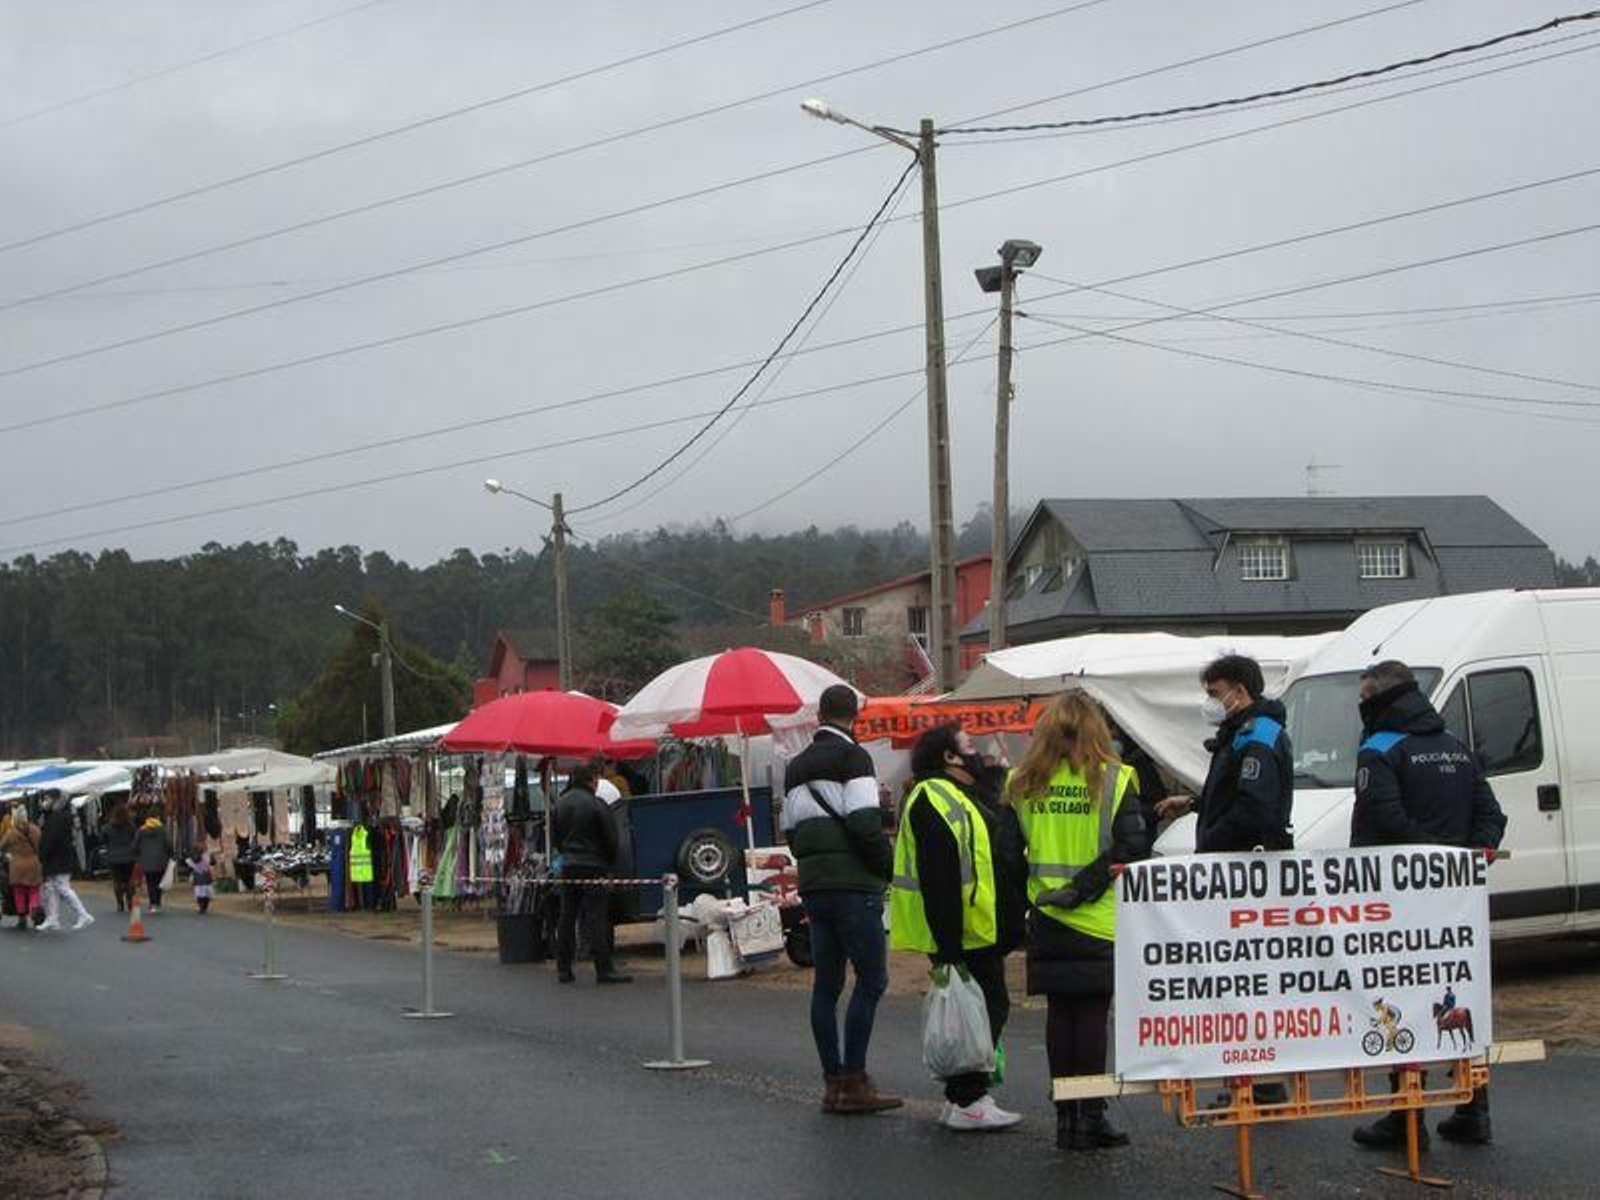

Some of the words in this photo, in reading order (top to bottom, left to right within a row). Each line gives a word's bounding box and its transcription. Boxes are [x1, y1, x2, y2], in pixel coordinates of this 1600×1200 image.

[1122, 860, 1268, 903] MERCADO
[1281, 856, 1317, 897] DE
[1323, 854, 1381, 896] SAN
[1392, 851, 1487, 891] COSME
[1229, 902, 1393, 929] PEÓNS
[1143, 935, 1335, 966] OBRIGATORIO
[1343, 925, 1474, 956] CIRCULAR
[1148, 973, 1269, 1001] SEMPRE
[1280, 968, 1352, 995] POLA
[1363, 960, 1473, 989] DEREITA
[1138, 1012, 1247, 1047] PROHIBIDO
[1254, 1011, 1267, 1041] O
[1274, 1008, 1322, 1039] PASO
[1222, 1047, 1277, 1065] GRAZAS
